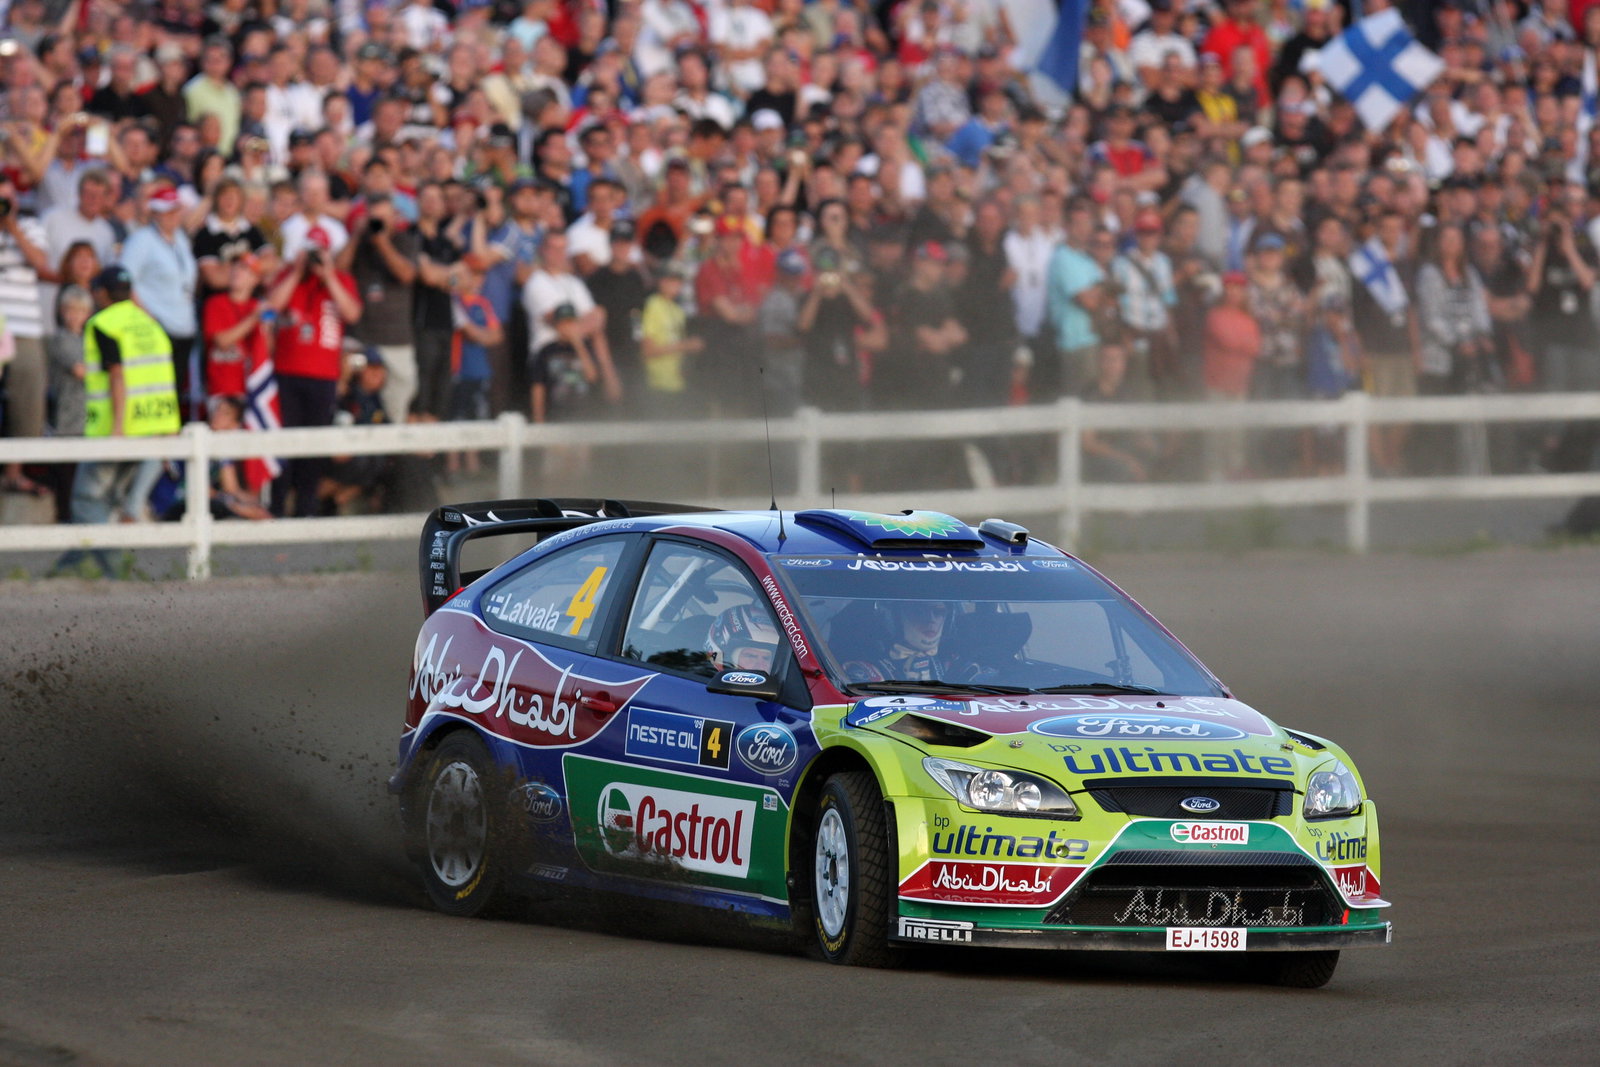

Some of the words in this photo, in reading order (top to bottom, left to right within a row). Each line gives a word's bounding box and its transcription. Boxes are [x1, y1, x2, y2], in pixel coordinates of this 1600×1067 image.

[786, 558, 823, 567] Ford
[1040, 559, 1070, 569] Ford
[498, 593, 560, 632] Latvala
[566, 566, 608, 636] 4
[763, 575, 808, 659] www.wrcford.com
[729, 673, 758, 684] Ford
[630, 724, 676, 746] NESTE
[678, 731, 698, 750] OIL
[1076, 716, 1211, 738] Ford
[707, 728, 721, 759] 4
[747, 729, 788, 767] Ford
[1048, 742, 1083, 755] bp
[1062, 747, 1295, 777] ultimate
[524, 788, 553, 817] Ford
[1190, 798, 1214, 810] Ford
[636, 795, 743, 866] Castrol
[934, 814, 950, 830] bp
[1191, 824, 1244, 842] Castrol
[1306, 826, 1323, 838] bp
[932, 825, 1090, 860] ultimate
[898, 916, 975, 942] PIRELLI
[1171, 929, 1239, 948] EJ-1598
